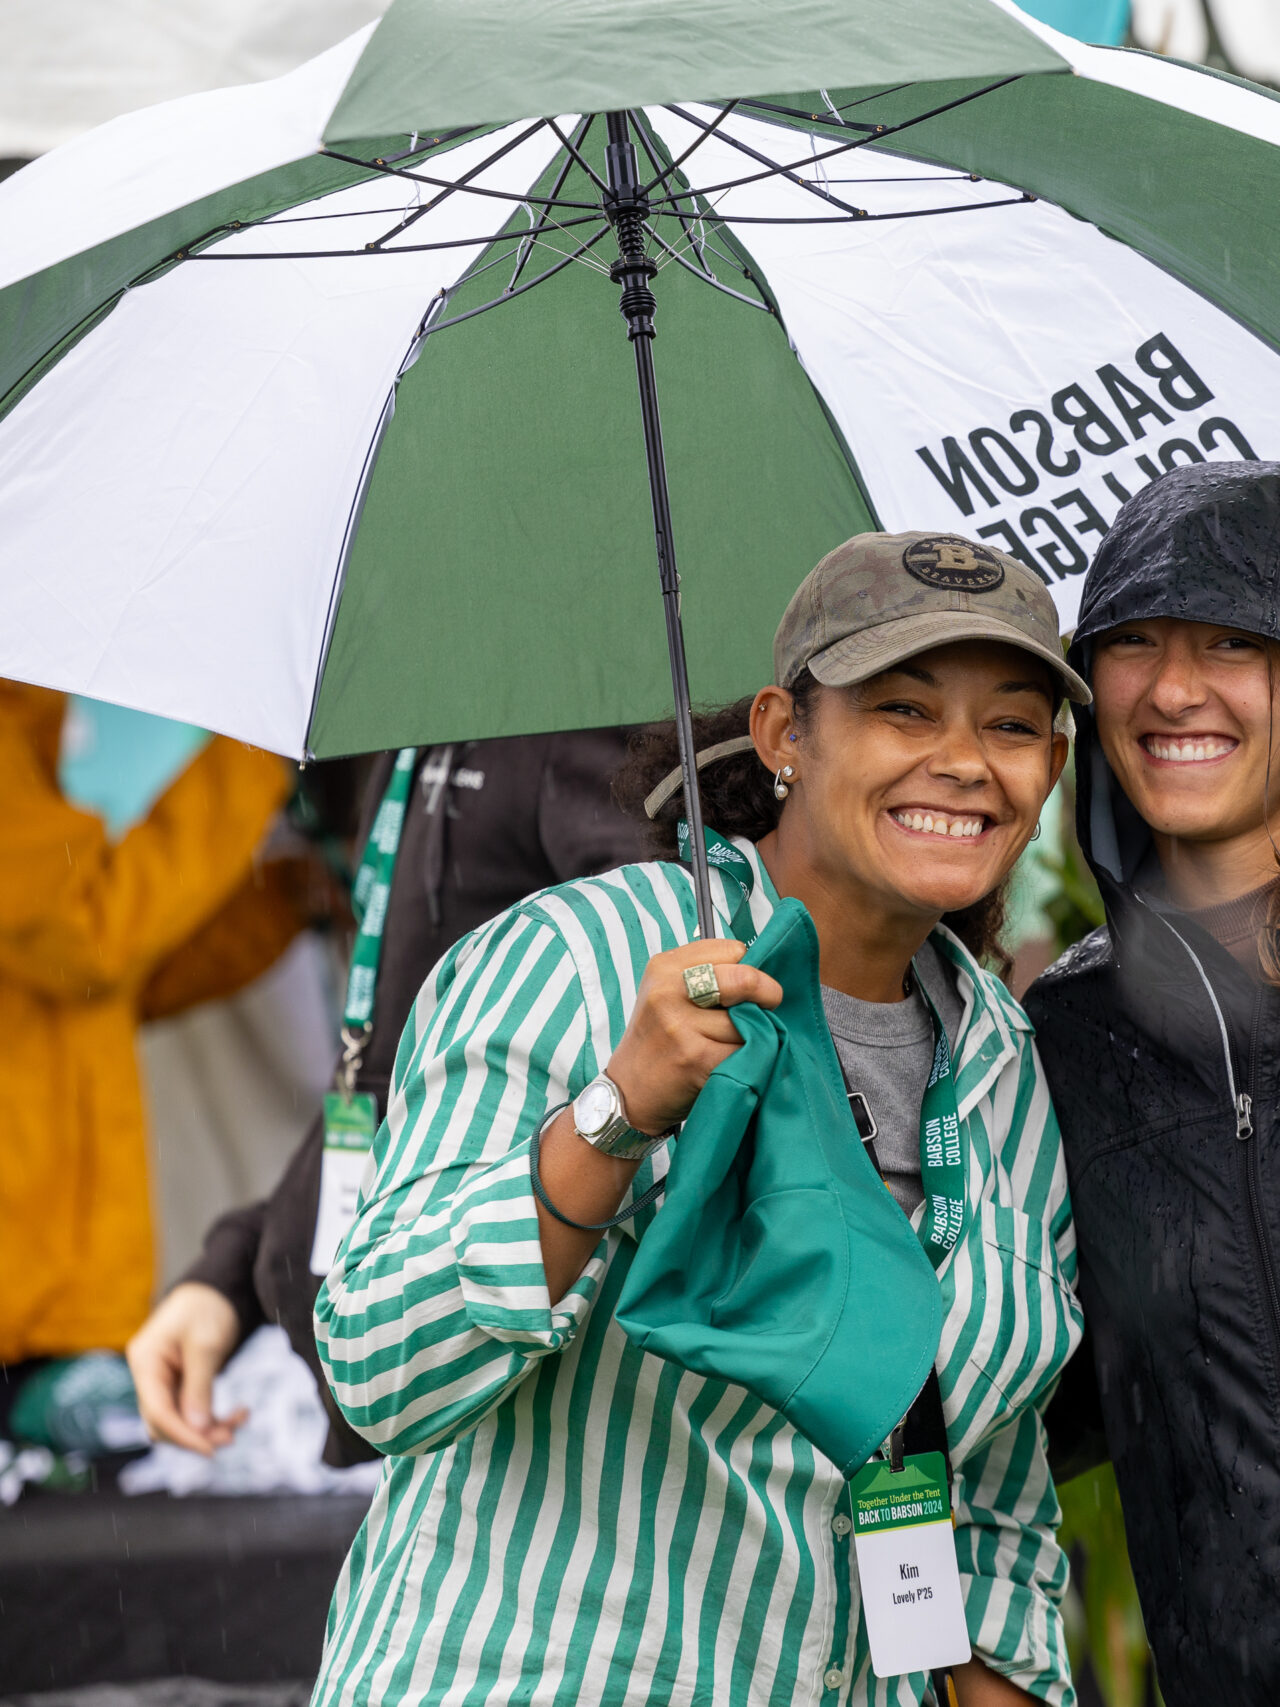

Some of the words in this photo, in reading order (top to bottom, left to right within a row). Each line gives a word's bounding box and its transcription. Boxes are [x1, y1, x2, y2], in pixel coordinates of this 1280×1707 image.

[932, 544, 979, 570] B
[922, 566, 996, 584] BEAVERS
[926, 1117, 944, 1167] BABSON
[942, 1112, 962, 1166] COLLEGE
[930, 1194, 948, 1245] BABSON
[942, 1198, 964, 1250] COLLEGE
[858, 1496, 888, 1510] Together
[889, 1492, 911, 1504] Under
[912, 1490, 924, 1500] the
[924, 1488, 940, 1498] Tent
[858, 1509, 880, 1525] BACK
[880, 1508, 890, 1521] TO
[890, 1502, 923, 1520] BABSON
[924, 1500, 943, 1515] 2024
[900, 1563, 920, 1580] Kim
[892, 1590, 915, 1604] Lovely
[916, 1586, 933, 1600] P'25
